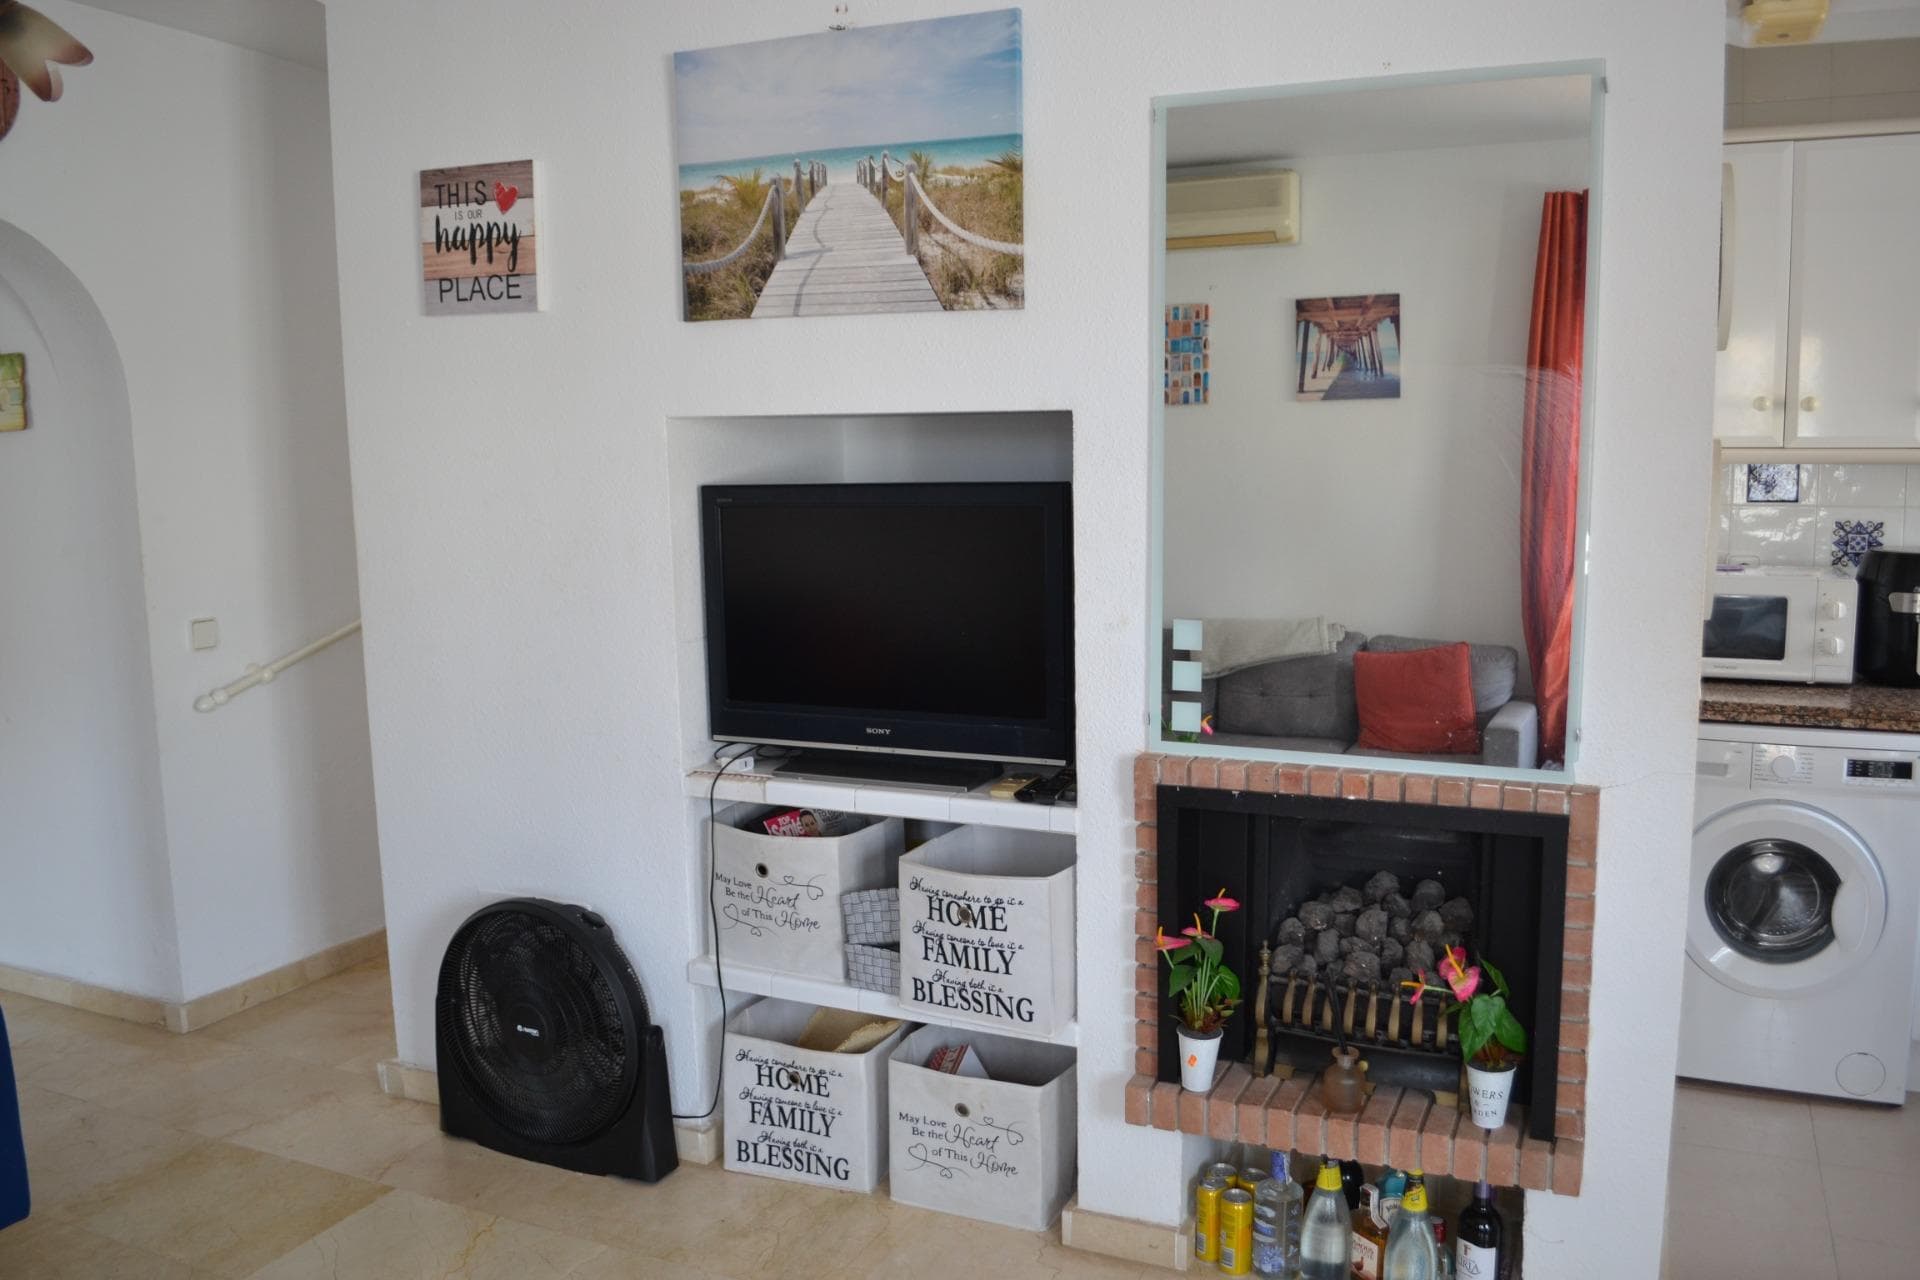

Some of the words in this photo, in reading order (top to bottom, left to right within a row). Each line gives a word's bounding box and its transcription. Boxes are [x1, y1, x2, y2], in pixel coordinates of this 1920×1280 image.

[434, 180, 487, 209] THIS
[454, 211, 464, 220] IS
[467, 209, 483, 220] OUR
[435, 214, 522, 272] happy
[438, 274, 522, 303] PLACE
[866, 727, 892, 735] SONY
[715, 872, 731, 885] May
[733, 877, 752, 889] Love
[725, 887, 736, 898] Be
[737, 890, 751, 900] the
[751, 885, 800, 909] Heart
[983, 895, 992, 904] to
[741, 908, 750, 916] of
[751, 908, 773, 921] This
[774, 910, 821, 933] Home
[926, 894, 1008, 932] HOME
[921, 935, 1017, 976] FAMILY
[977, 937, 987, 947] to
[912, 976, 1035, 1023] BLESSING
[755, 1063, 830, 1098] HOME
[749, 1100, 836, 1138] FAMILY
[899, 1112, 920, 1124] May
[923, 1116, 947, 1128] Love
[1473, 1108, 1497, 1118] DEN
[912, 1127, 926, 1137] Be
[928, 1129, 944, 1140] the
[944, 1123, 1000, 1153] Heart
[736, 1139, 850, 1181] BLESSING
[931, 1147, 942, 1157] of
[945, 1148, 968, 1162] This
[969, 1151, 1019, 1178] Home
